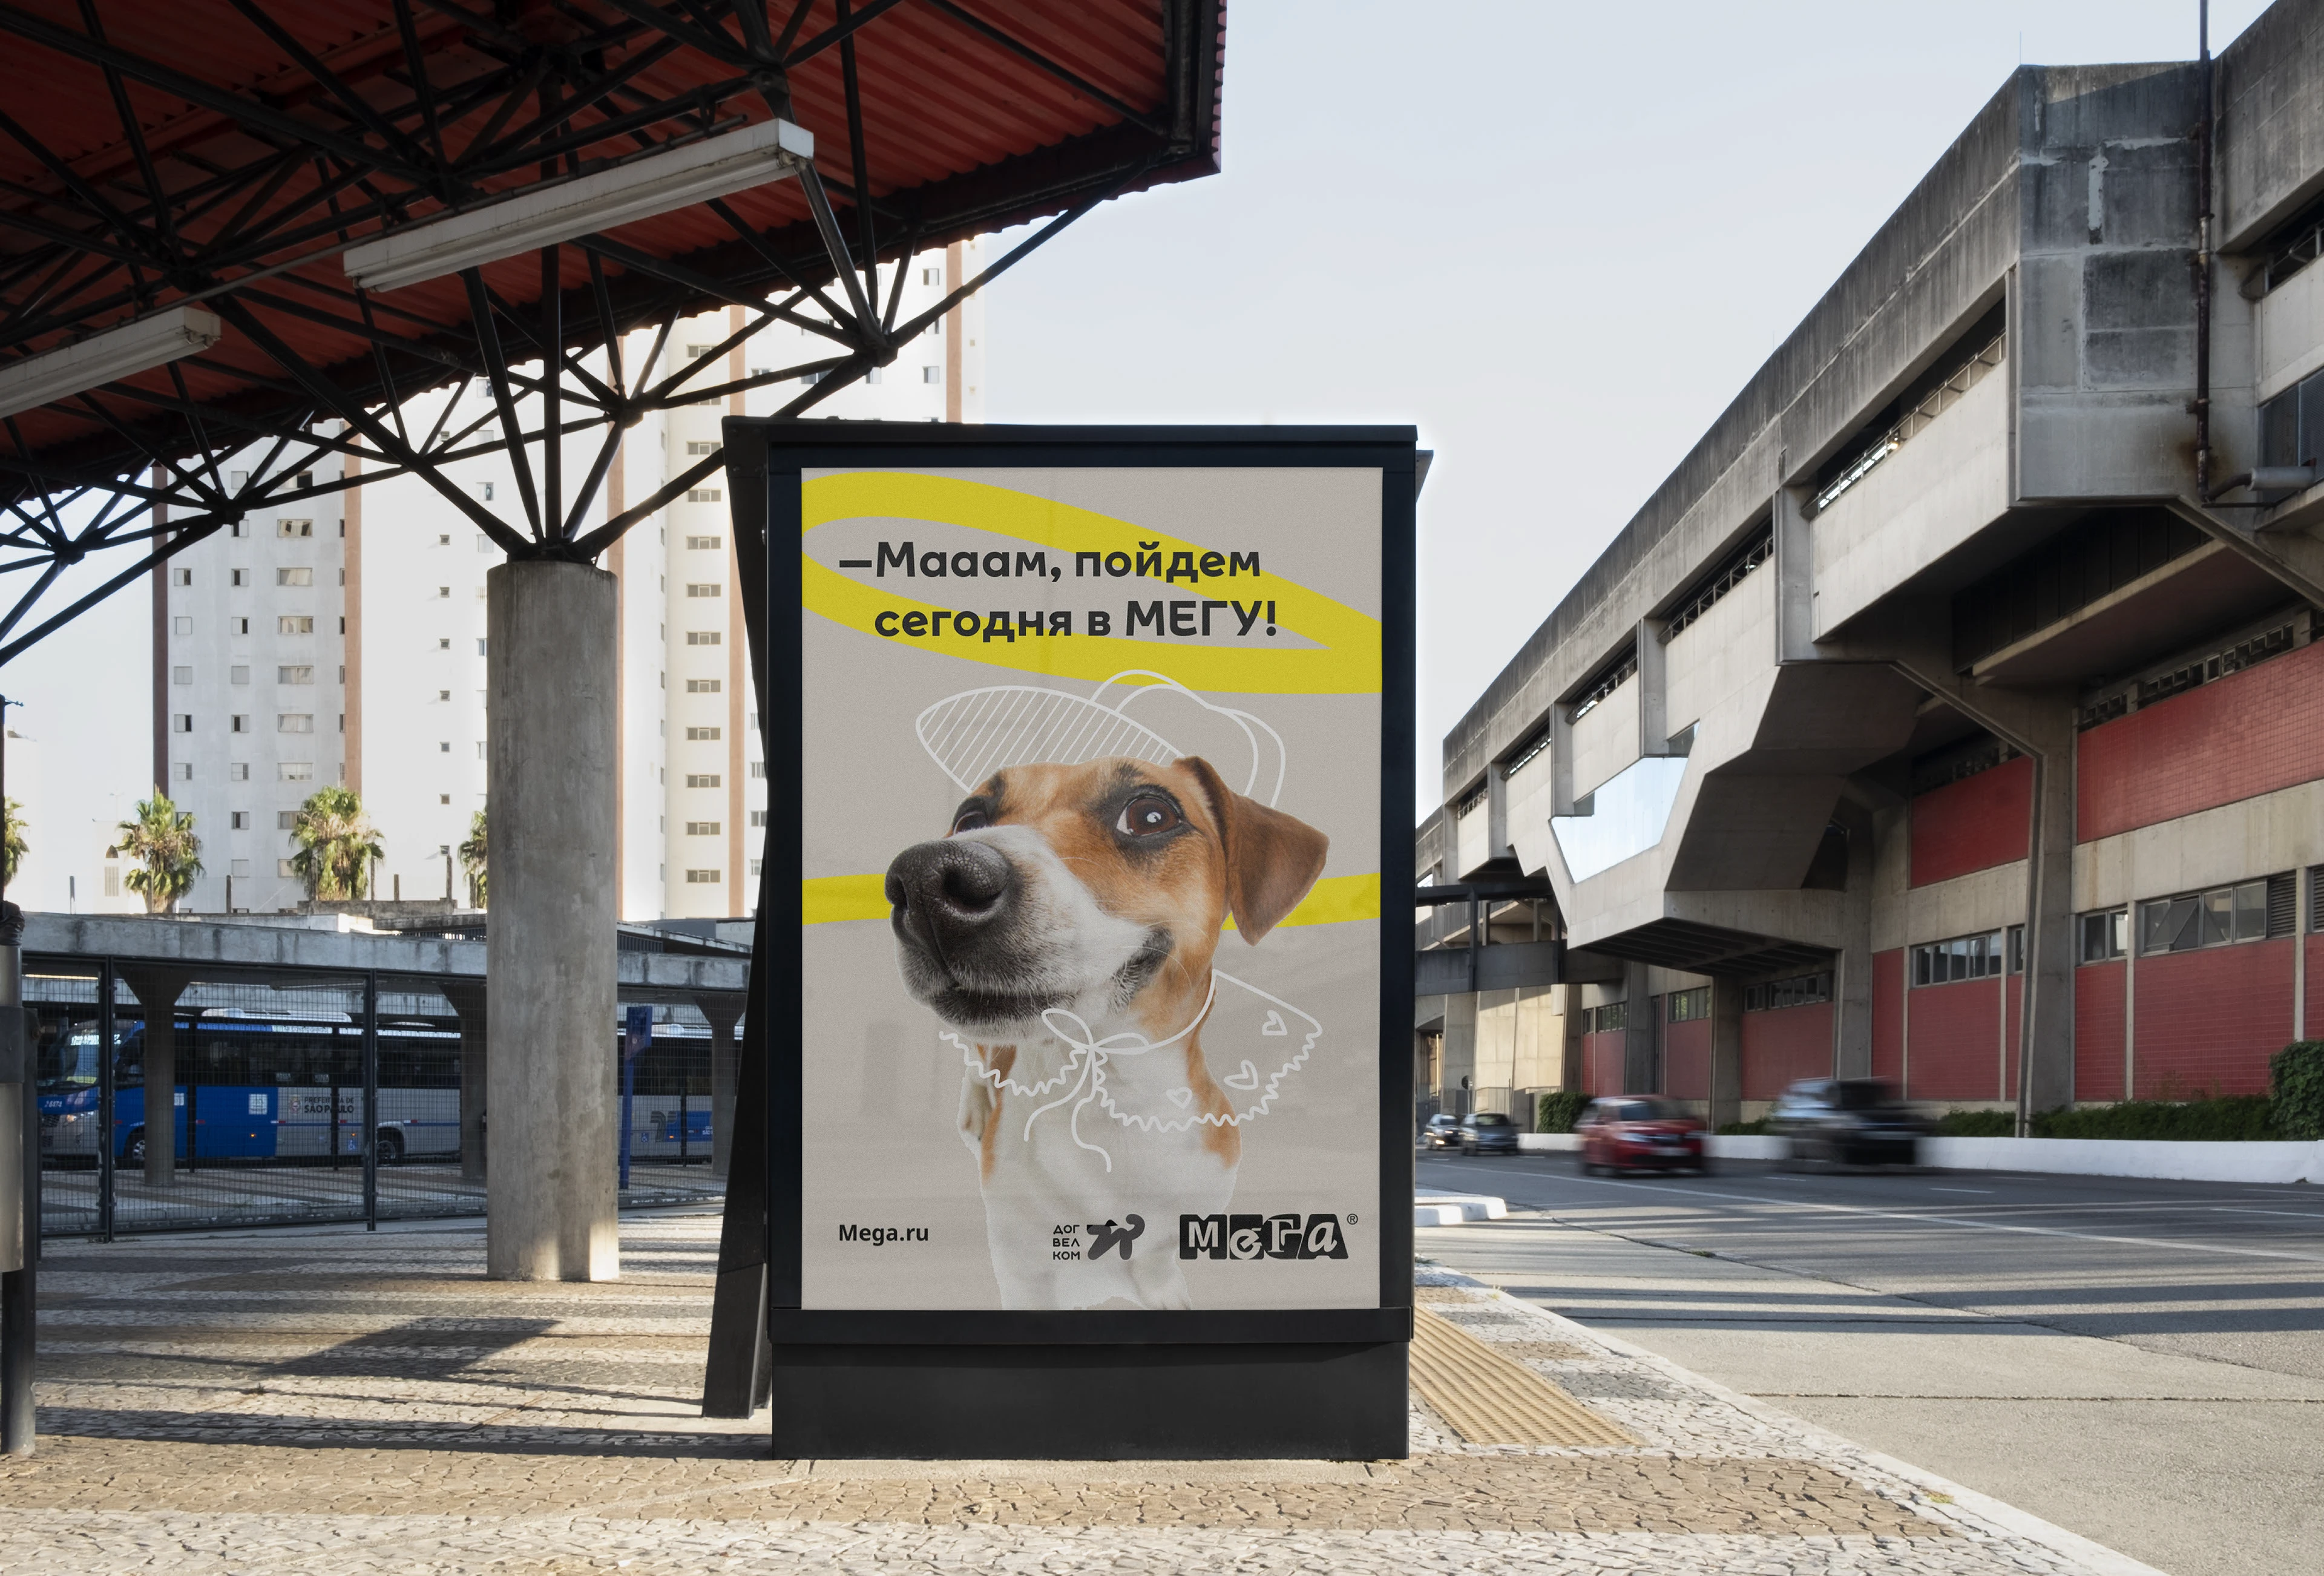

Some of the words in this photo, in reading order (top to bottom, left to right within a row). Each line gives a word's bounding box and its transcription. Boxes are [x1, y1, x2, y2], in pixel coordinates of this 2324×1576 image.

[1075, 541, 1260, 583] пойдем
[875, 611, 1072, 643] сегодня
[1088, 611, 1111, 636] в
[1126, 600, 1276, 637] МЕГУ!
[324, 1105, 354, 1113] PULO
[1053, 1224, 1080, 1235] ДОГ
[839, 1224, 928, 1247] Mega.ru
[1053, 1238, 1080, 1247] ВЕЛ
[1053, 1251, 1080, 1260] КОМ
